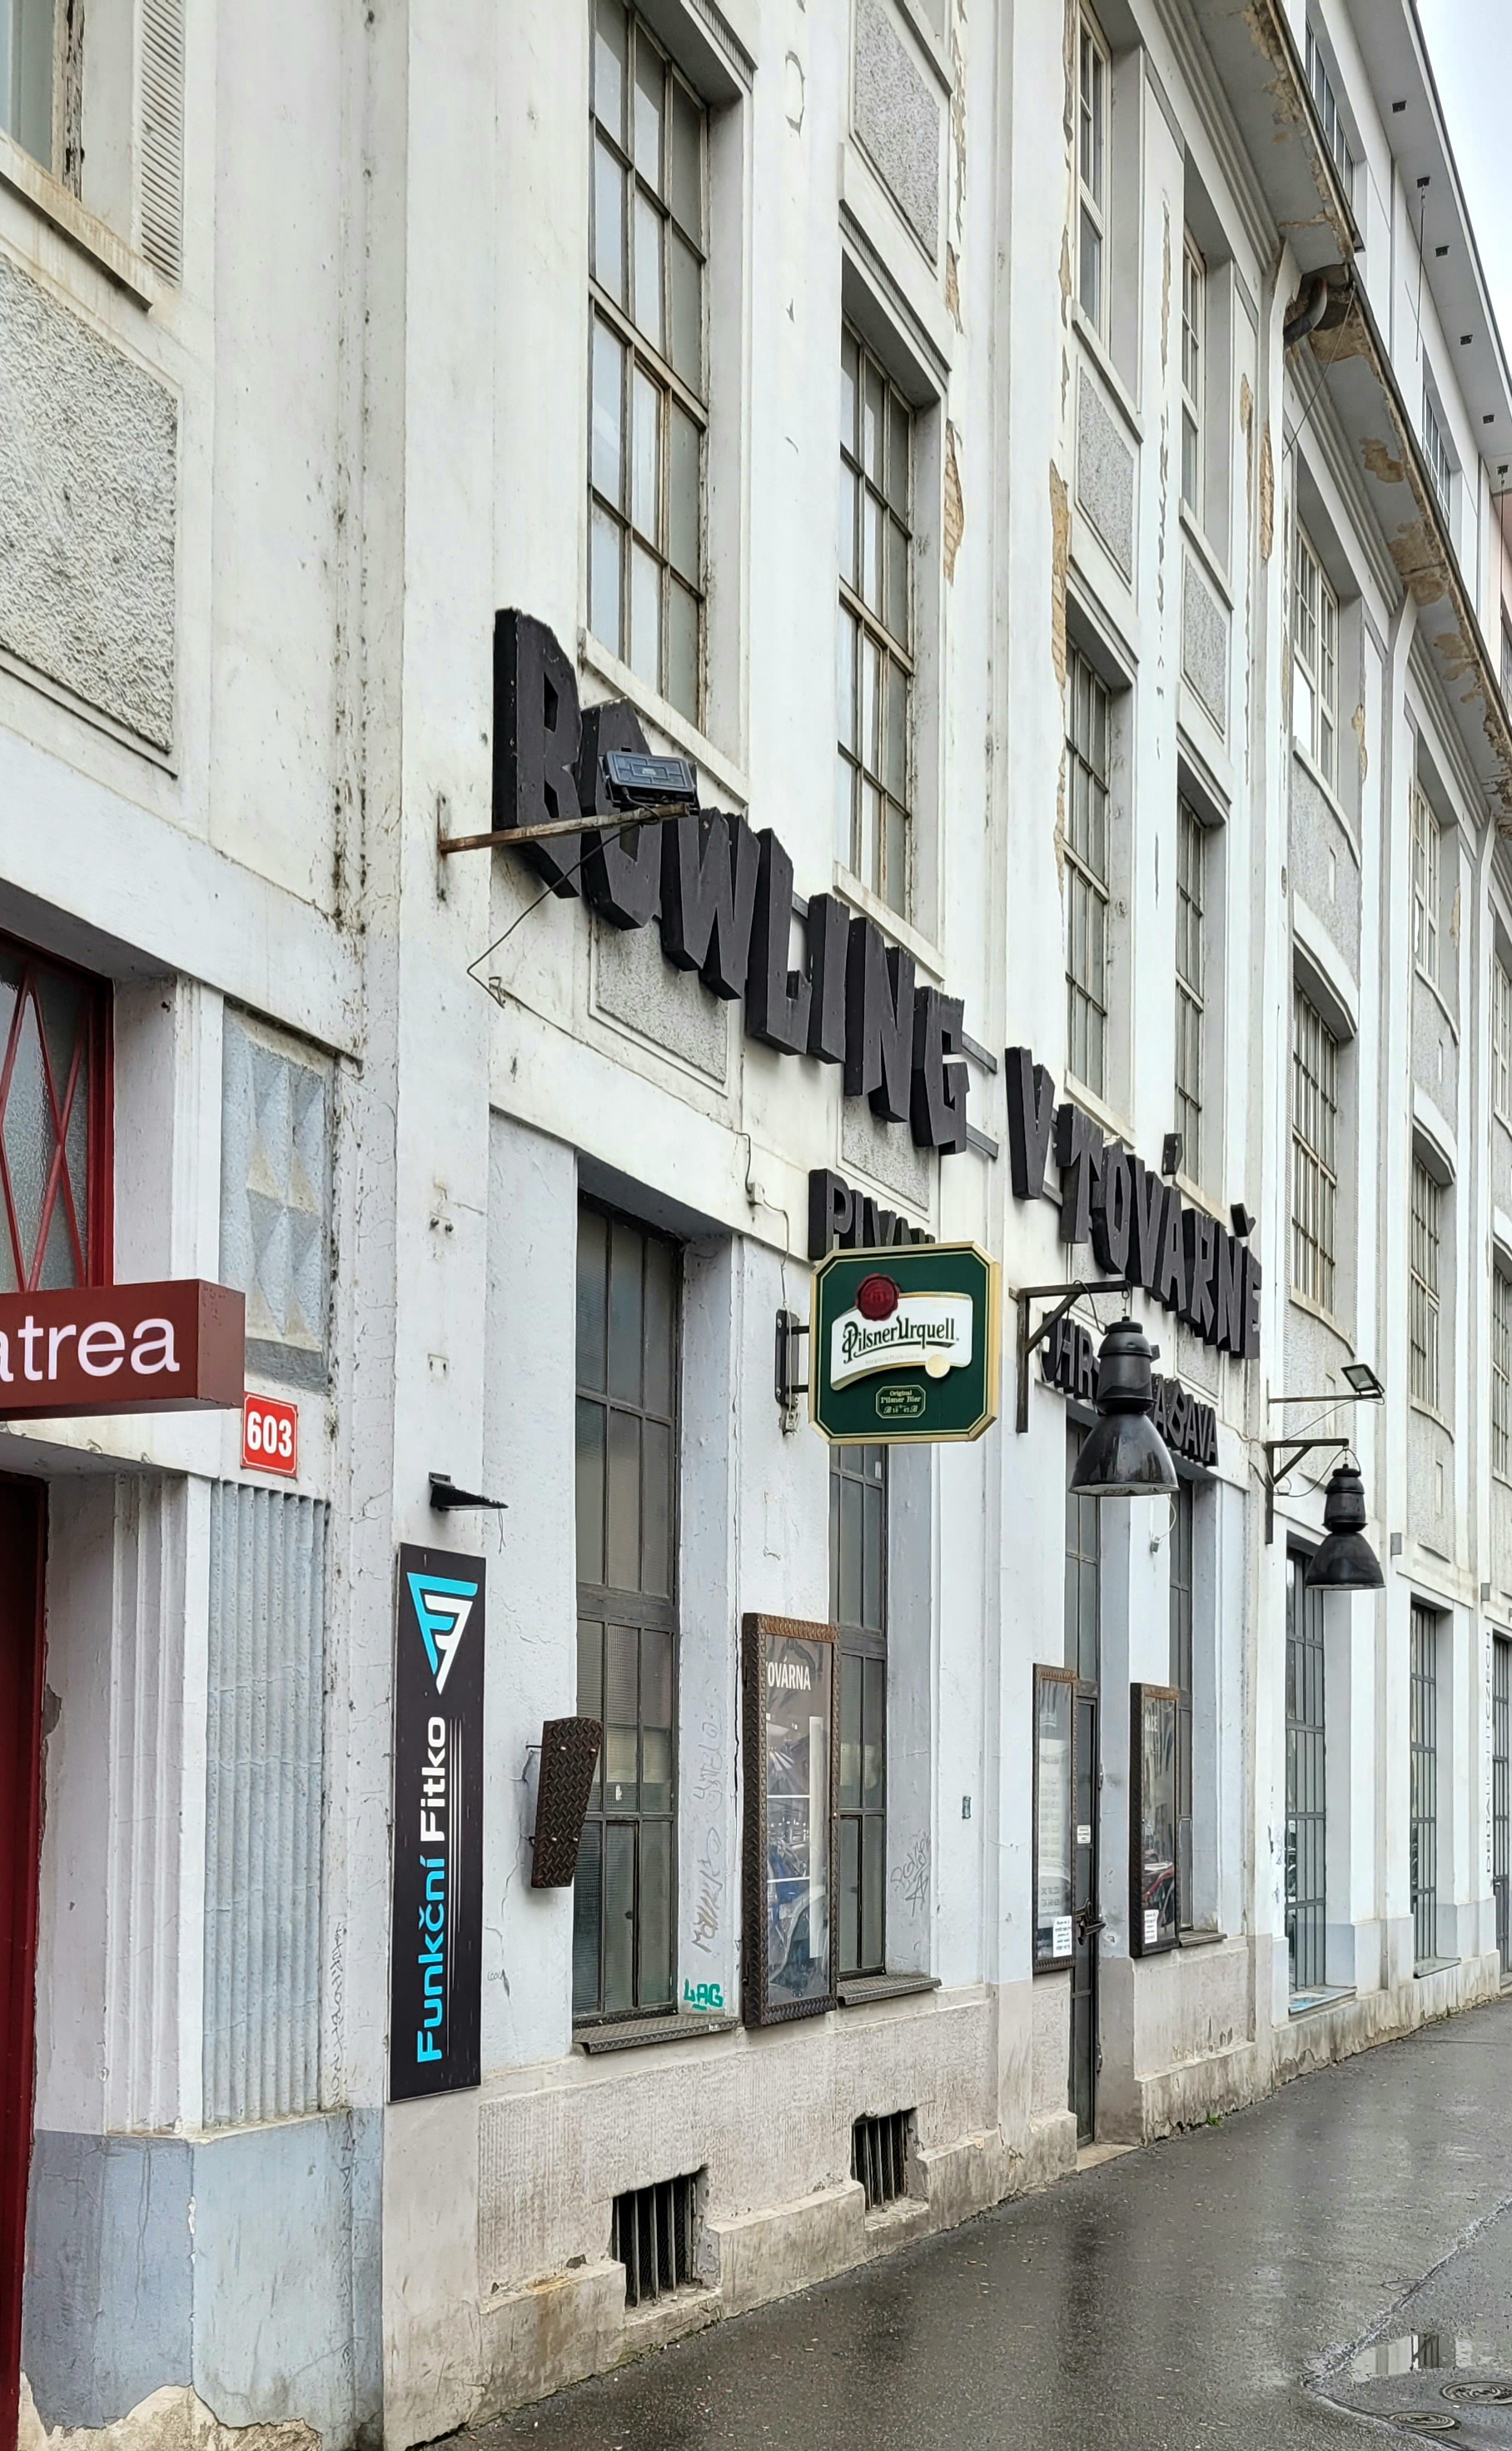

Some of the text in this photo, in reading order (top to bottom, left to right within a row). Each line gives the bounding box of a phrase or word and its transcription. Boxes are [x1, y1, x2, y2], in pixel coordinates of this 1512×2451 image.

[492, 608, 1262, 1359] BOWLING V TOVÁRNĚ
[0, 1315, 180, 1382] trea
[842, 1315, 955, 1364] Pilsner Urquell
[247, 1411, 292, 1457] 603
[766, 1656, 812, 1691] OVÁRNA
[416, 1716, 446, 2064] Funkční Fitko
